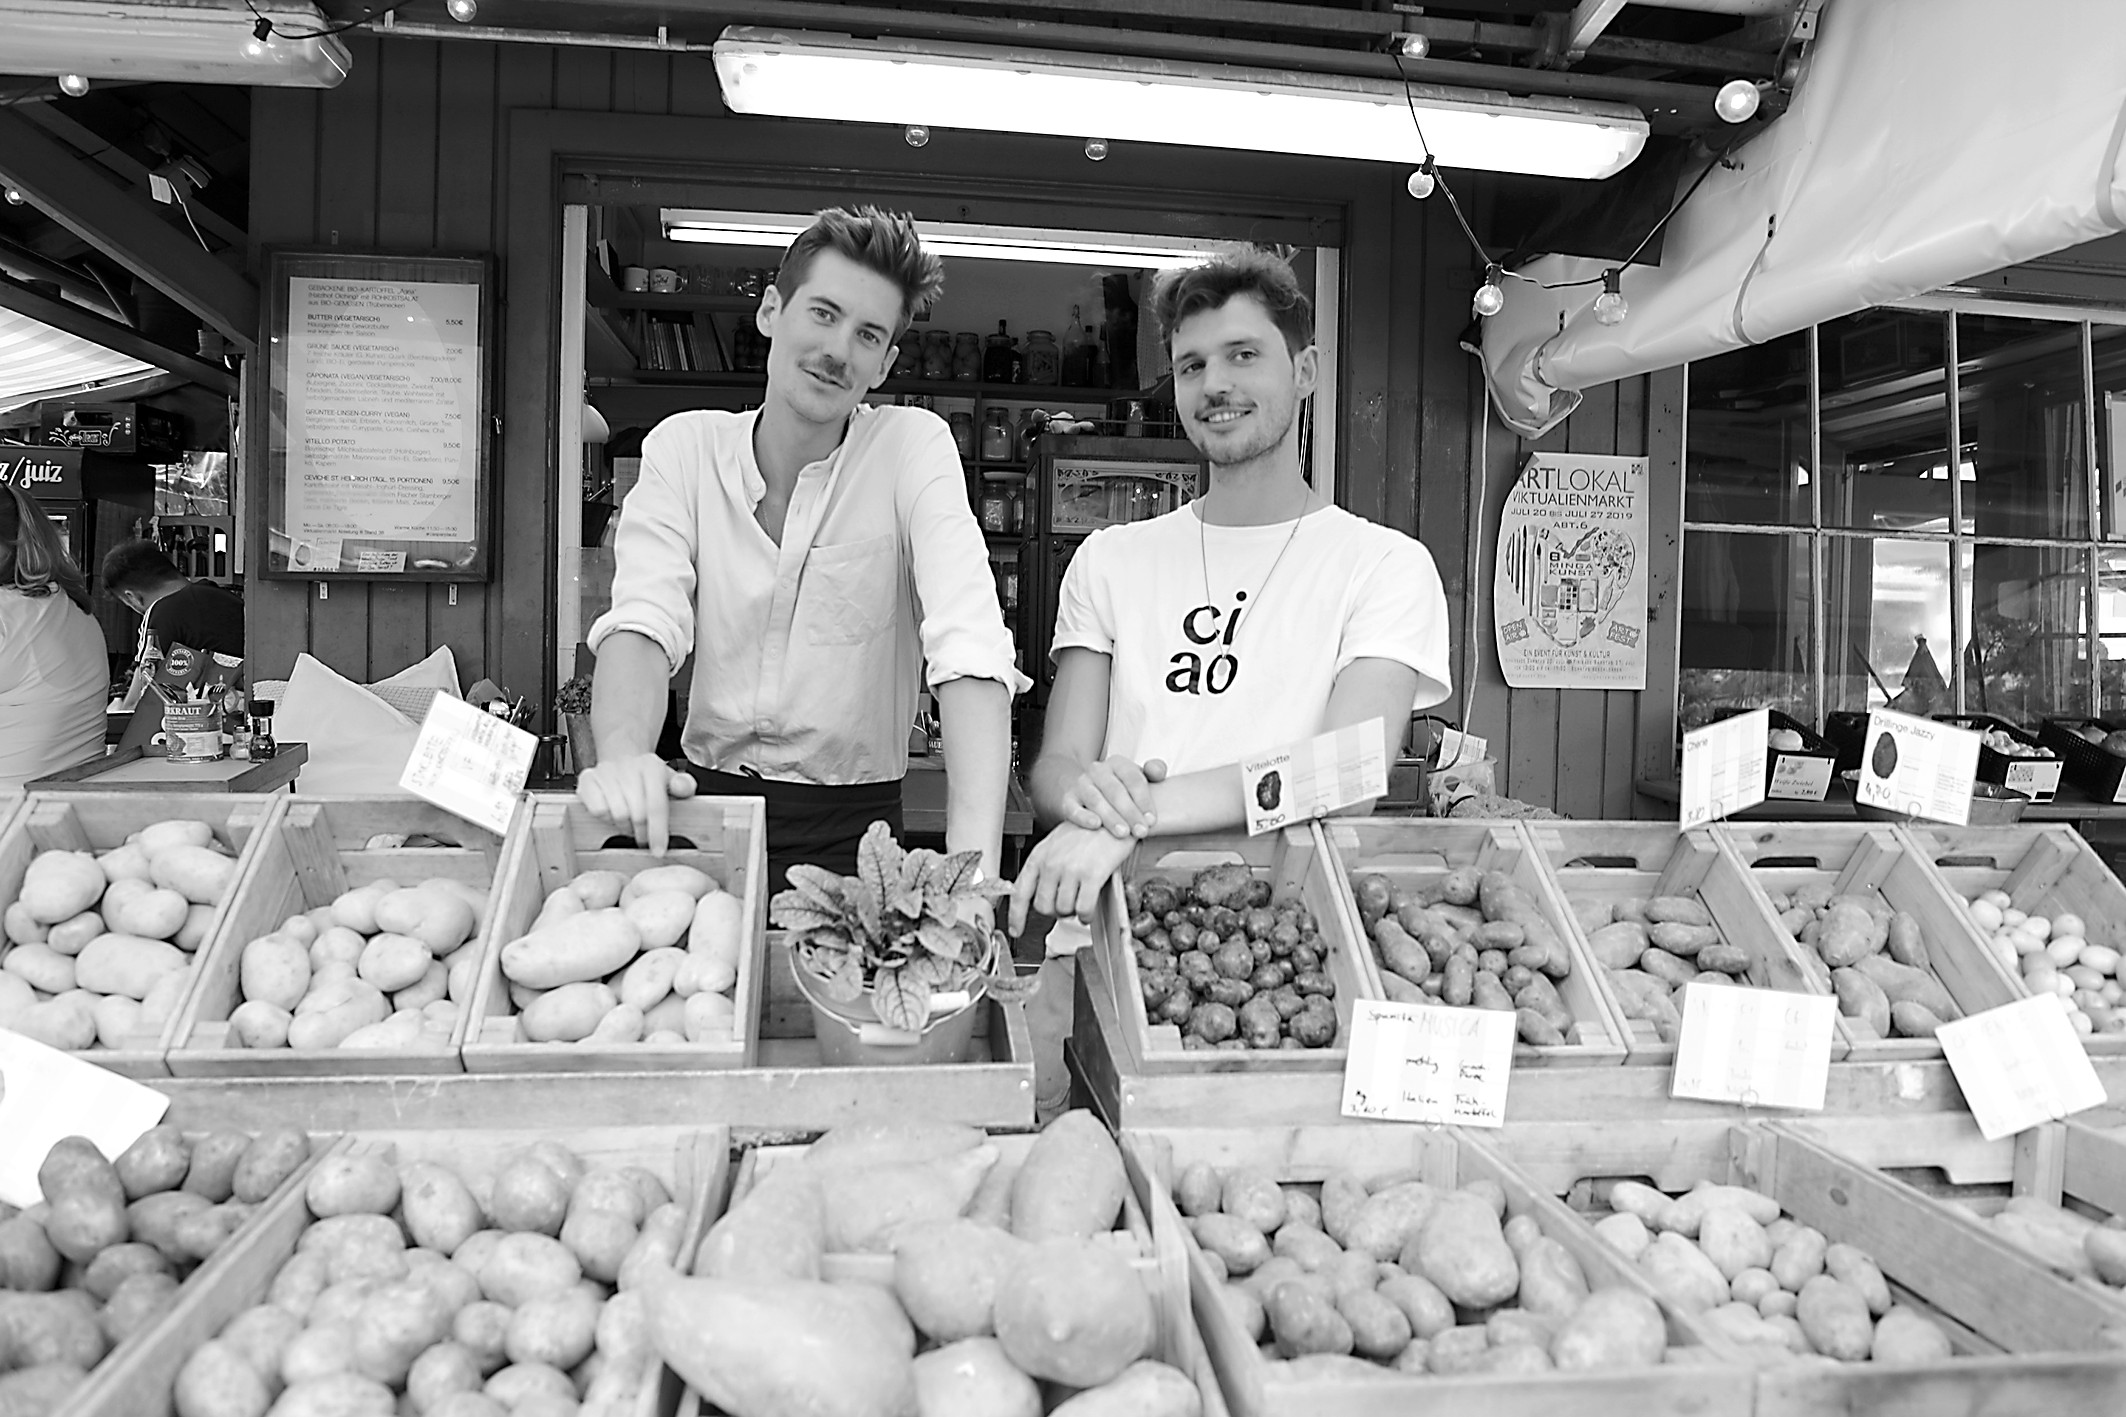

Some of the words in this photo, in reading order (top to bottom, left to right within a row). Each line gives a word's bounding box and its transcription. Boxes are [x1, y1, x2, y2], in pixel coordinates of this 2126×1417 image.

[307, 313, 333, 321] BUTTER
[352, 344, 400, 352] (VEGETARISCH)
[306, 371, 339, 379] CAPONATA
[340, 373, 411, 382] (VEGAN/VEGETARISCH)
[304, 437, 331, 445] VITELLO
[331, 438, 356, 446] POTATO
[303, 474, 330, 482] CEVICHE
[397, 476, 434, 485] PORTIONEN)
[1512, 491, 1635, 508] VIKTUALIENMARKT
[1511, 508, 1530, 516] JULI
[1533, 509, 1547, 517] 20
[1564, 510, 1587, 518] JULI
[1590, 511, 1603, 519] 27
[1606, 512, 1633, 520] 2019
[1549, 562, 1594, 570] MINGA
[1549, 569, 1593, 577] KUNST
[1183, 591, 1247, 645] ci
[1502, 622, 1523, 635] OPEN
[1612, 624, 1630, 637] ART
[1505, 632, 1519, 643] AIR
[1523, 649, 1533, 657] EIN
[1534, 649, 1551, 657] EVENT
[1564, 649, 1582, 658] KUNST
[1589, 650, 1612, 659] KULTUR
[171, 658, 189, 667] 100%
[1165, 652, 1238, 695] ao
[1874, 715, 1909, 733] Drillinge
[1910, 724, 1936, 741] Jazzy
[1246, 754, 1291, 773] Vitelotte
